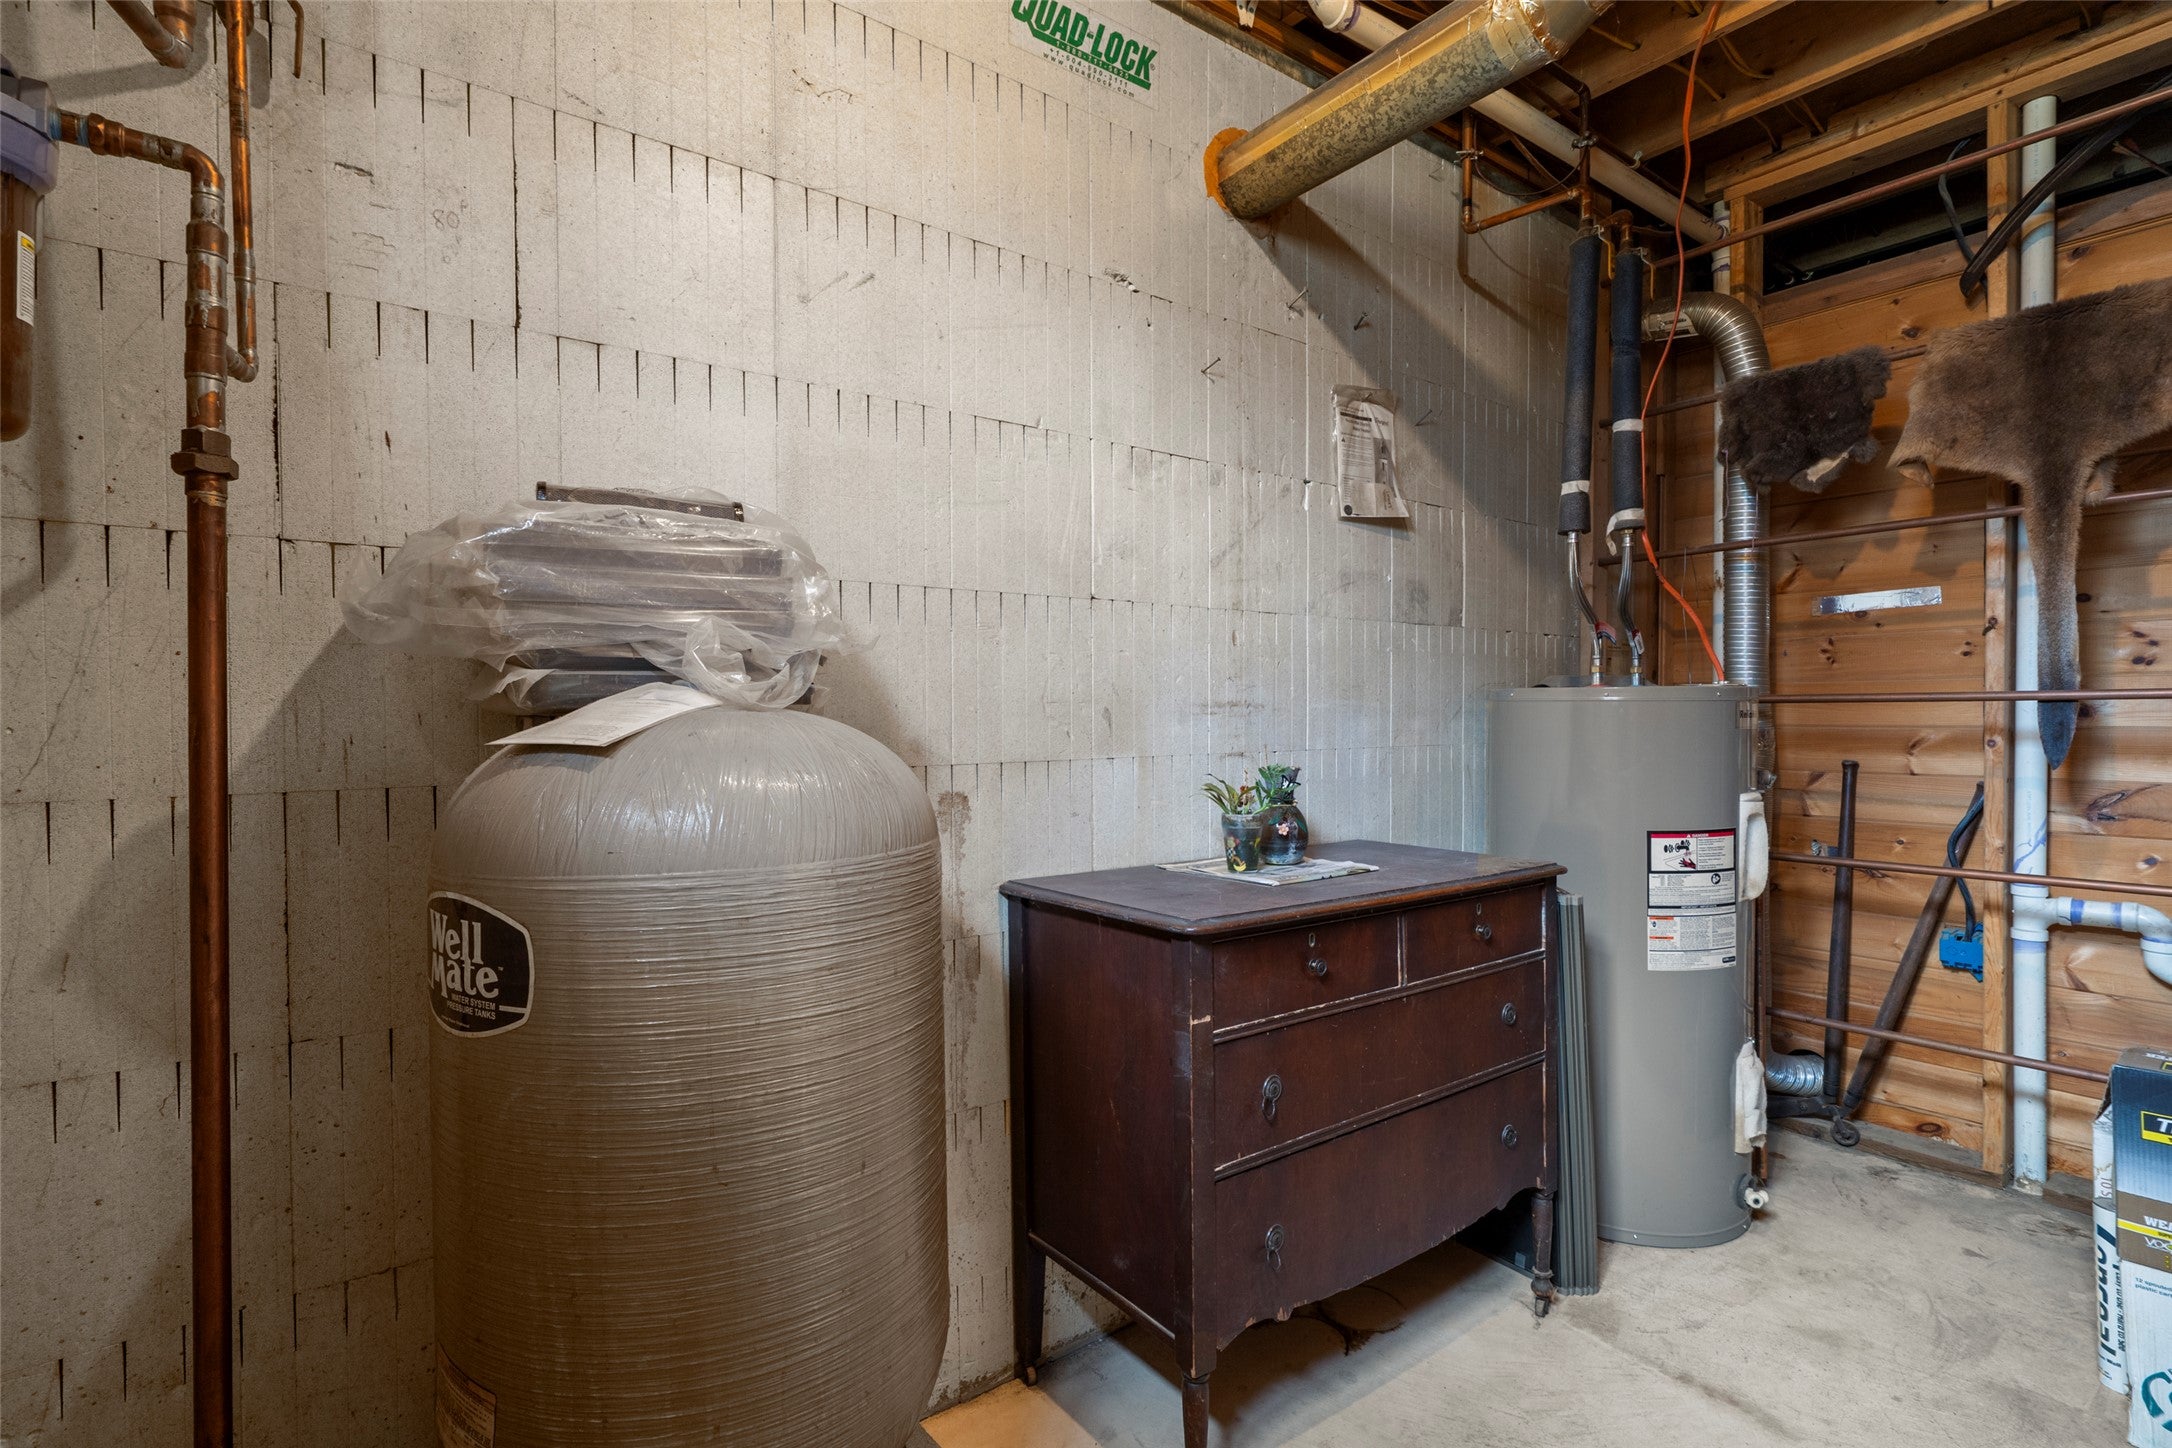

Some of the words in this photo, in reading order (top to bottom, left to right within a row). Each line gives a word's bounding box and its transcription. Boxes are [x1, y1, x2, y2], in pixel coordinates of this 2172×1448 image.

[1011, 0, 1157, 83] QUAD-LOCK
[1043, 52, 1135, 98] www.quadlock.com
[430, 908, 484, 965] Well
[428, 952, 499, 999] Mate
[446, 1001, 474, 1016] PRESSURE
[474, 1009, 496, 1021] TANKS
[470, 998, 496, 1011] SYSTEM
